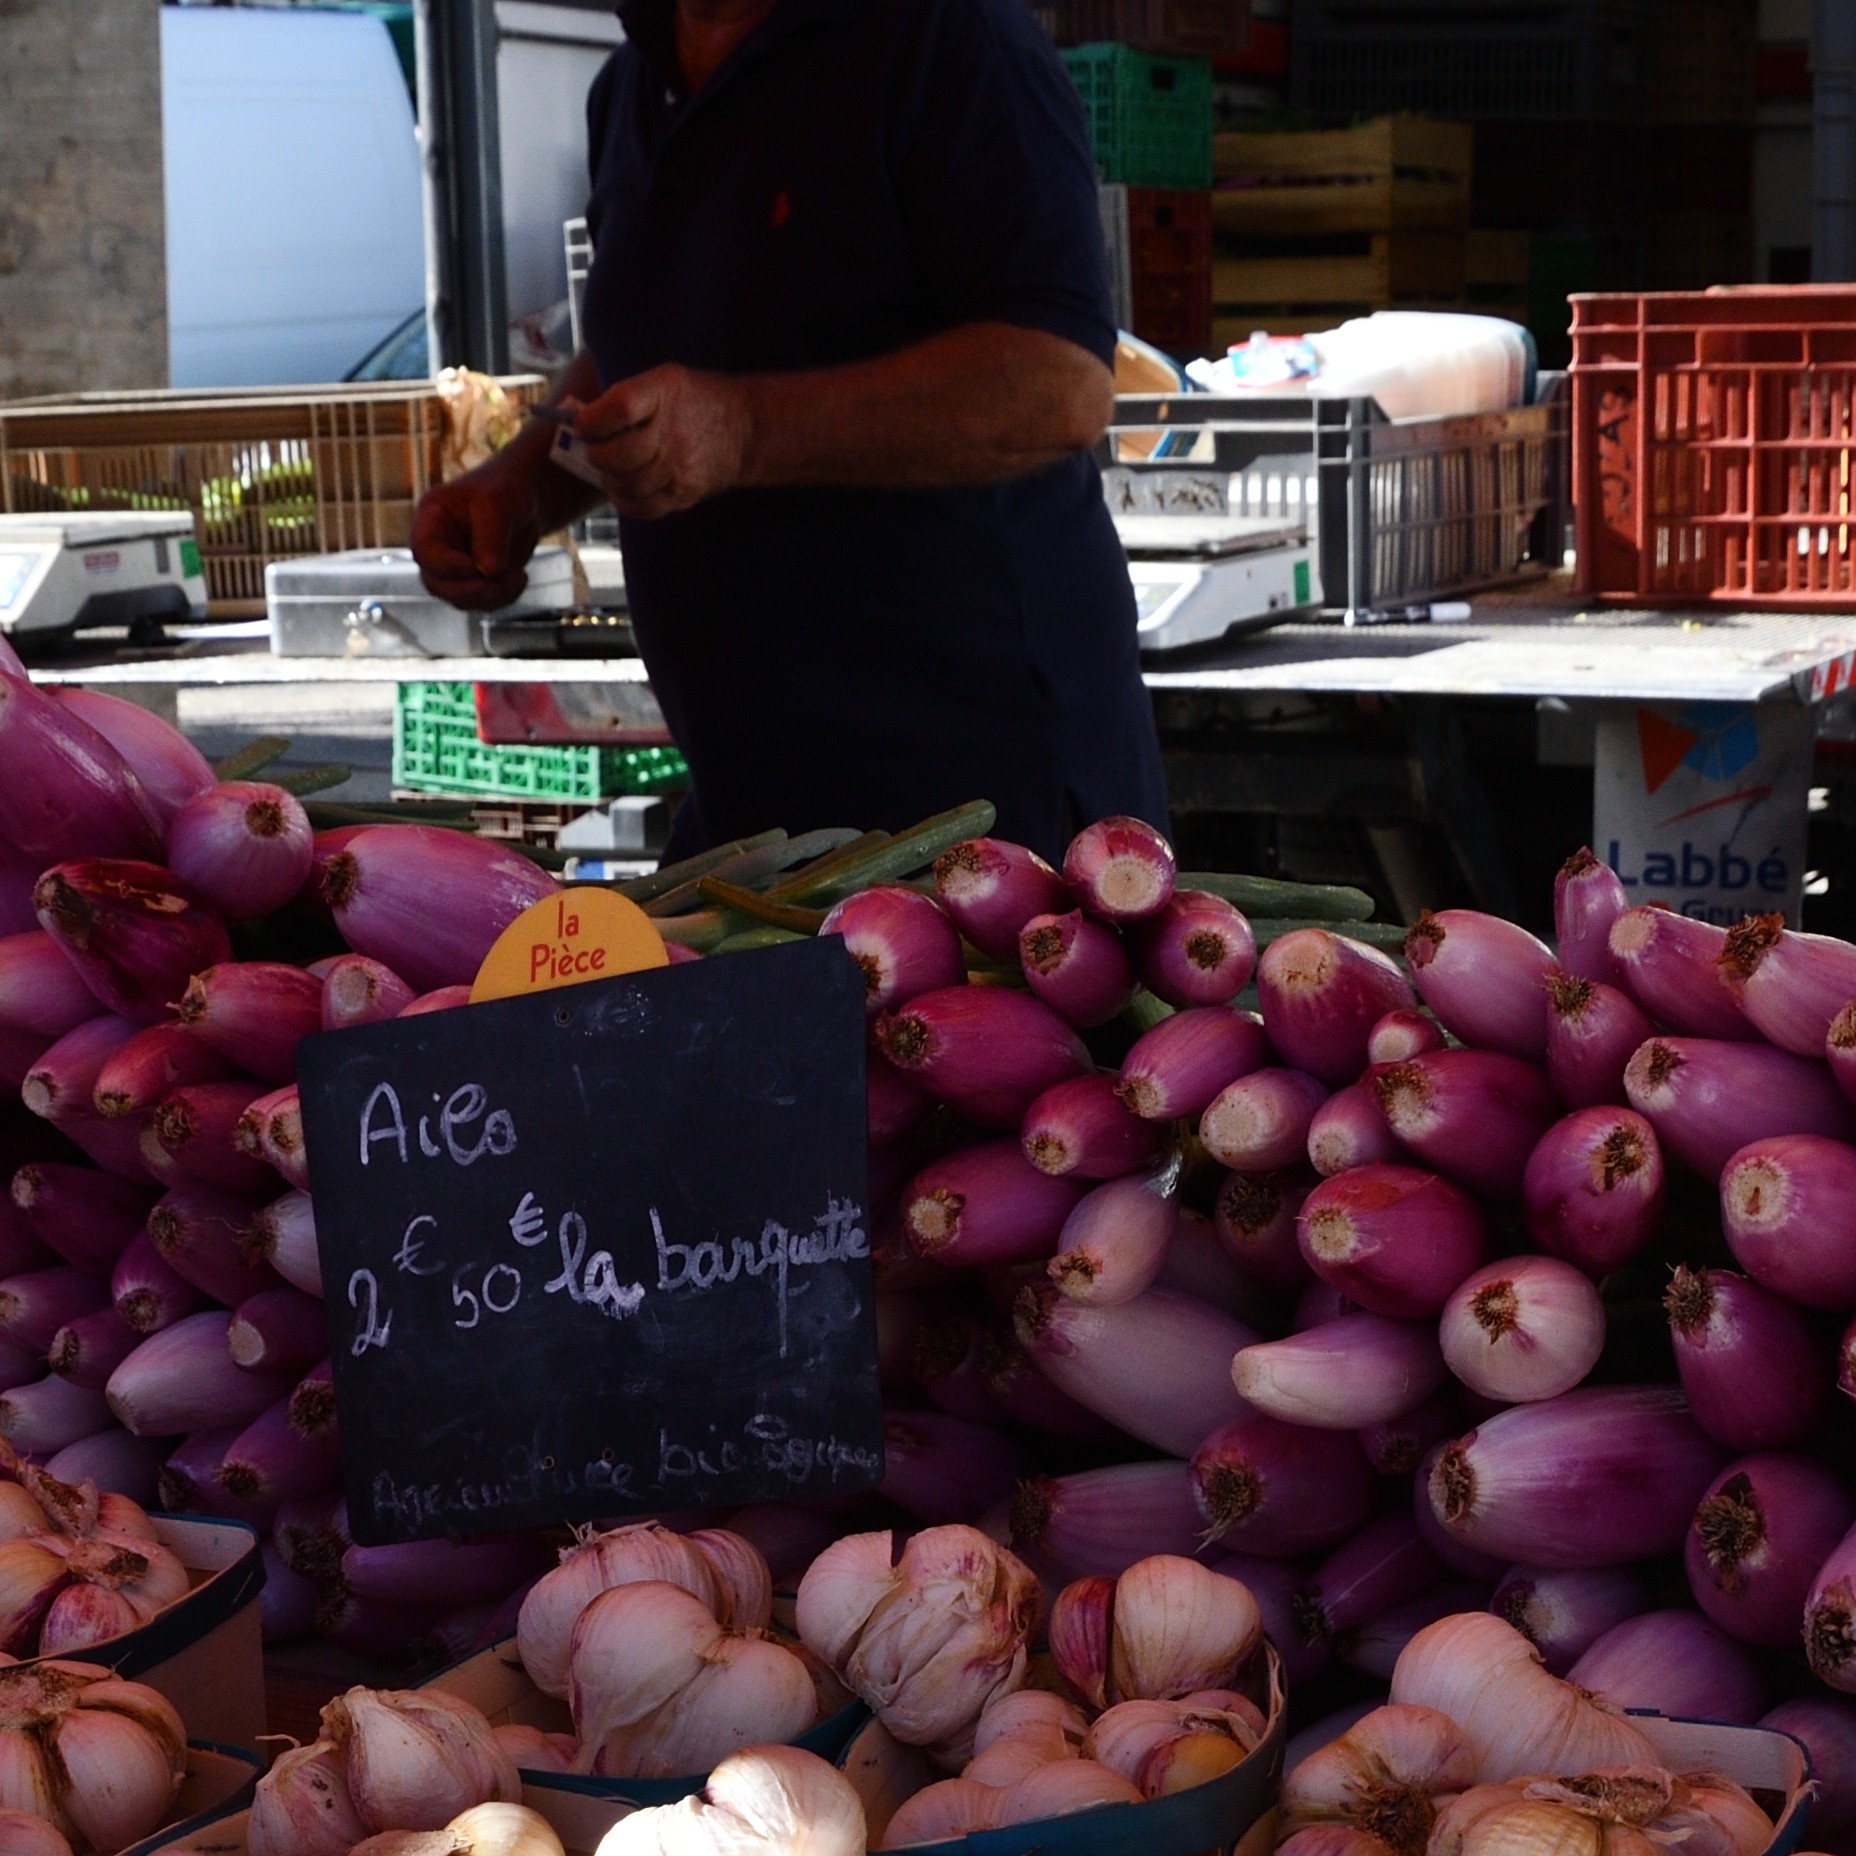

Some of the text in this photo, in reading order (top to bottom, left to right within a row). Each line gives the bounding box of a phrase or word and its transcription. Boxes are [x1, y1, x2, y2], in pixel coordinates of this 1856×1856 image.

[1607, 840, 1789, 893] Labbé
[558, 901, 580, 938] la
[530, 943, 607, 983] Pièce
[545, 1210, 646, 1321] la
[649, 1190, 871, 1359] barquette
